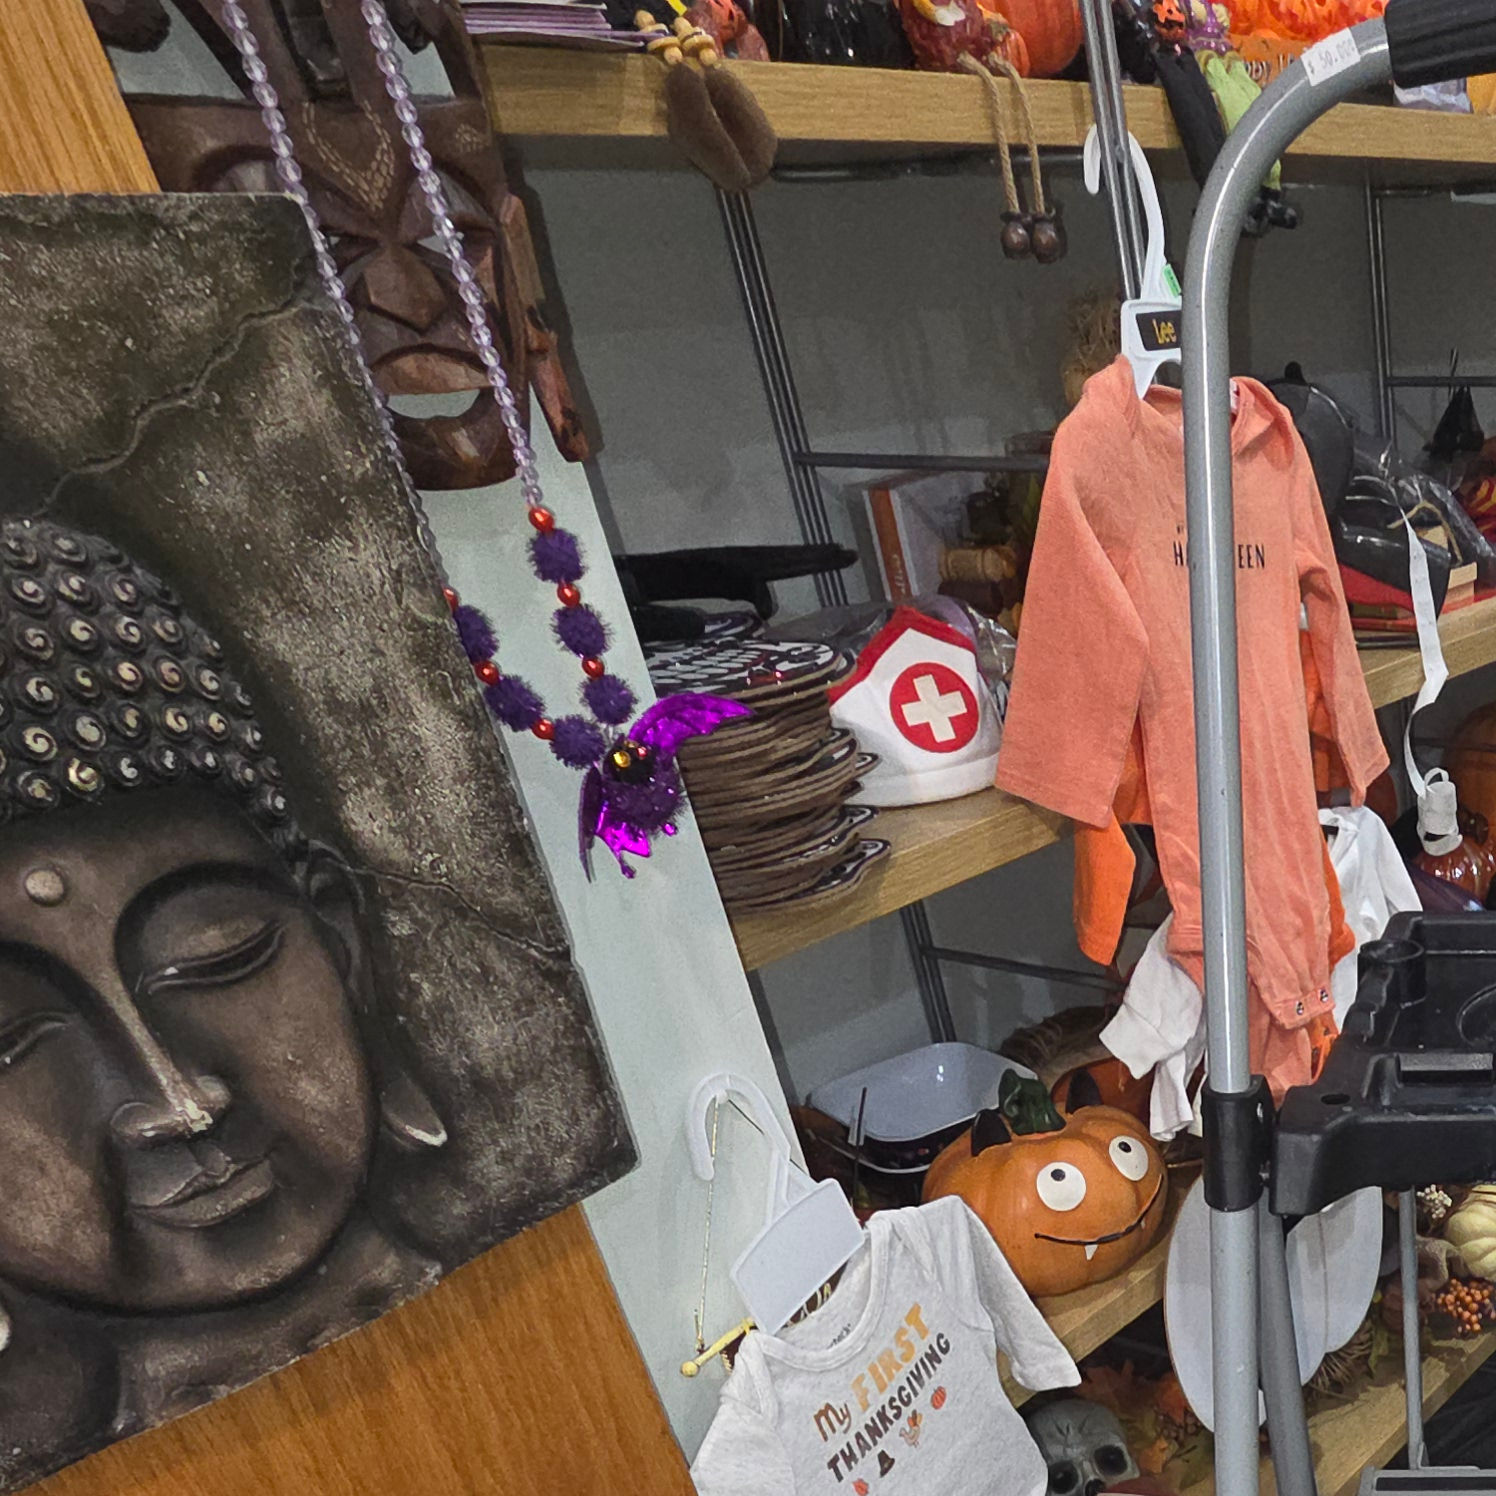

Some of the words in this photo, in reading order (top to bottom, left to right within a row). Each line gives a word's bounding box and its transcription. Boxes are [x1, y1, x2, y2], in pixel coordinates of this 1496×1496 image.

[1151, 318, 1178, 345] Lee
[813, 1402, 852, 1442] My
[851, 1302, 930, 1412] FIRST
[827, 1332, 951, 1483] THANKSGIVING
